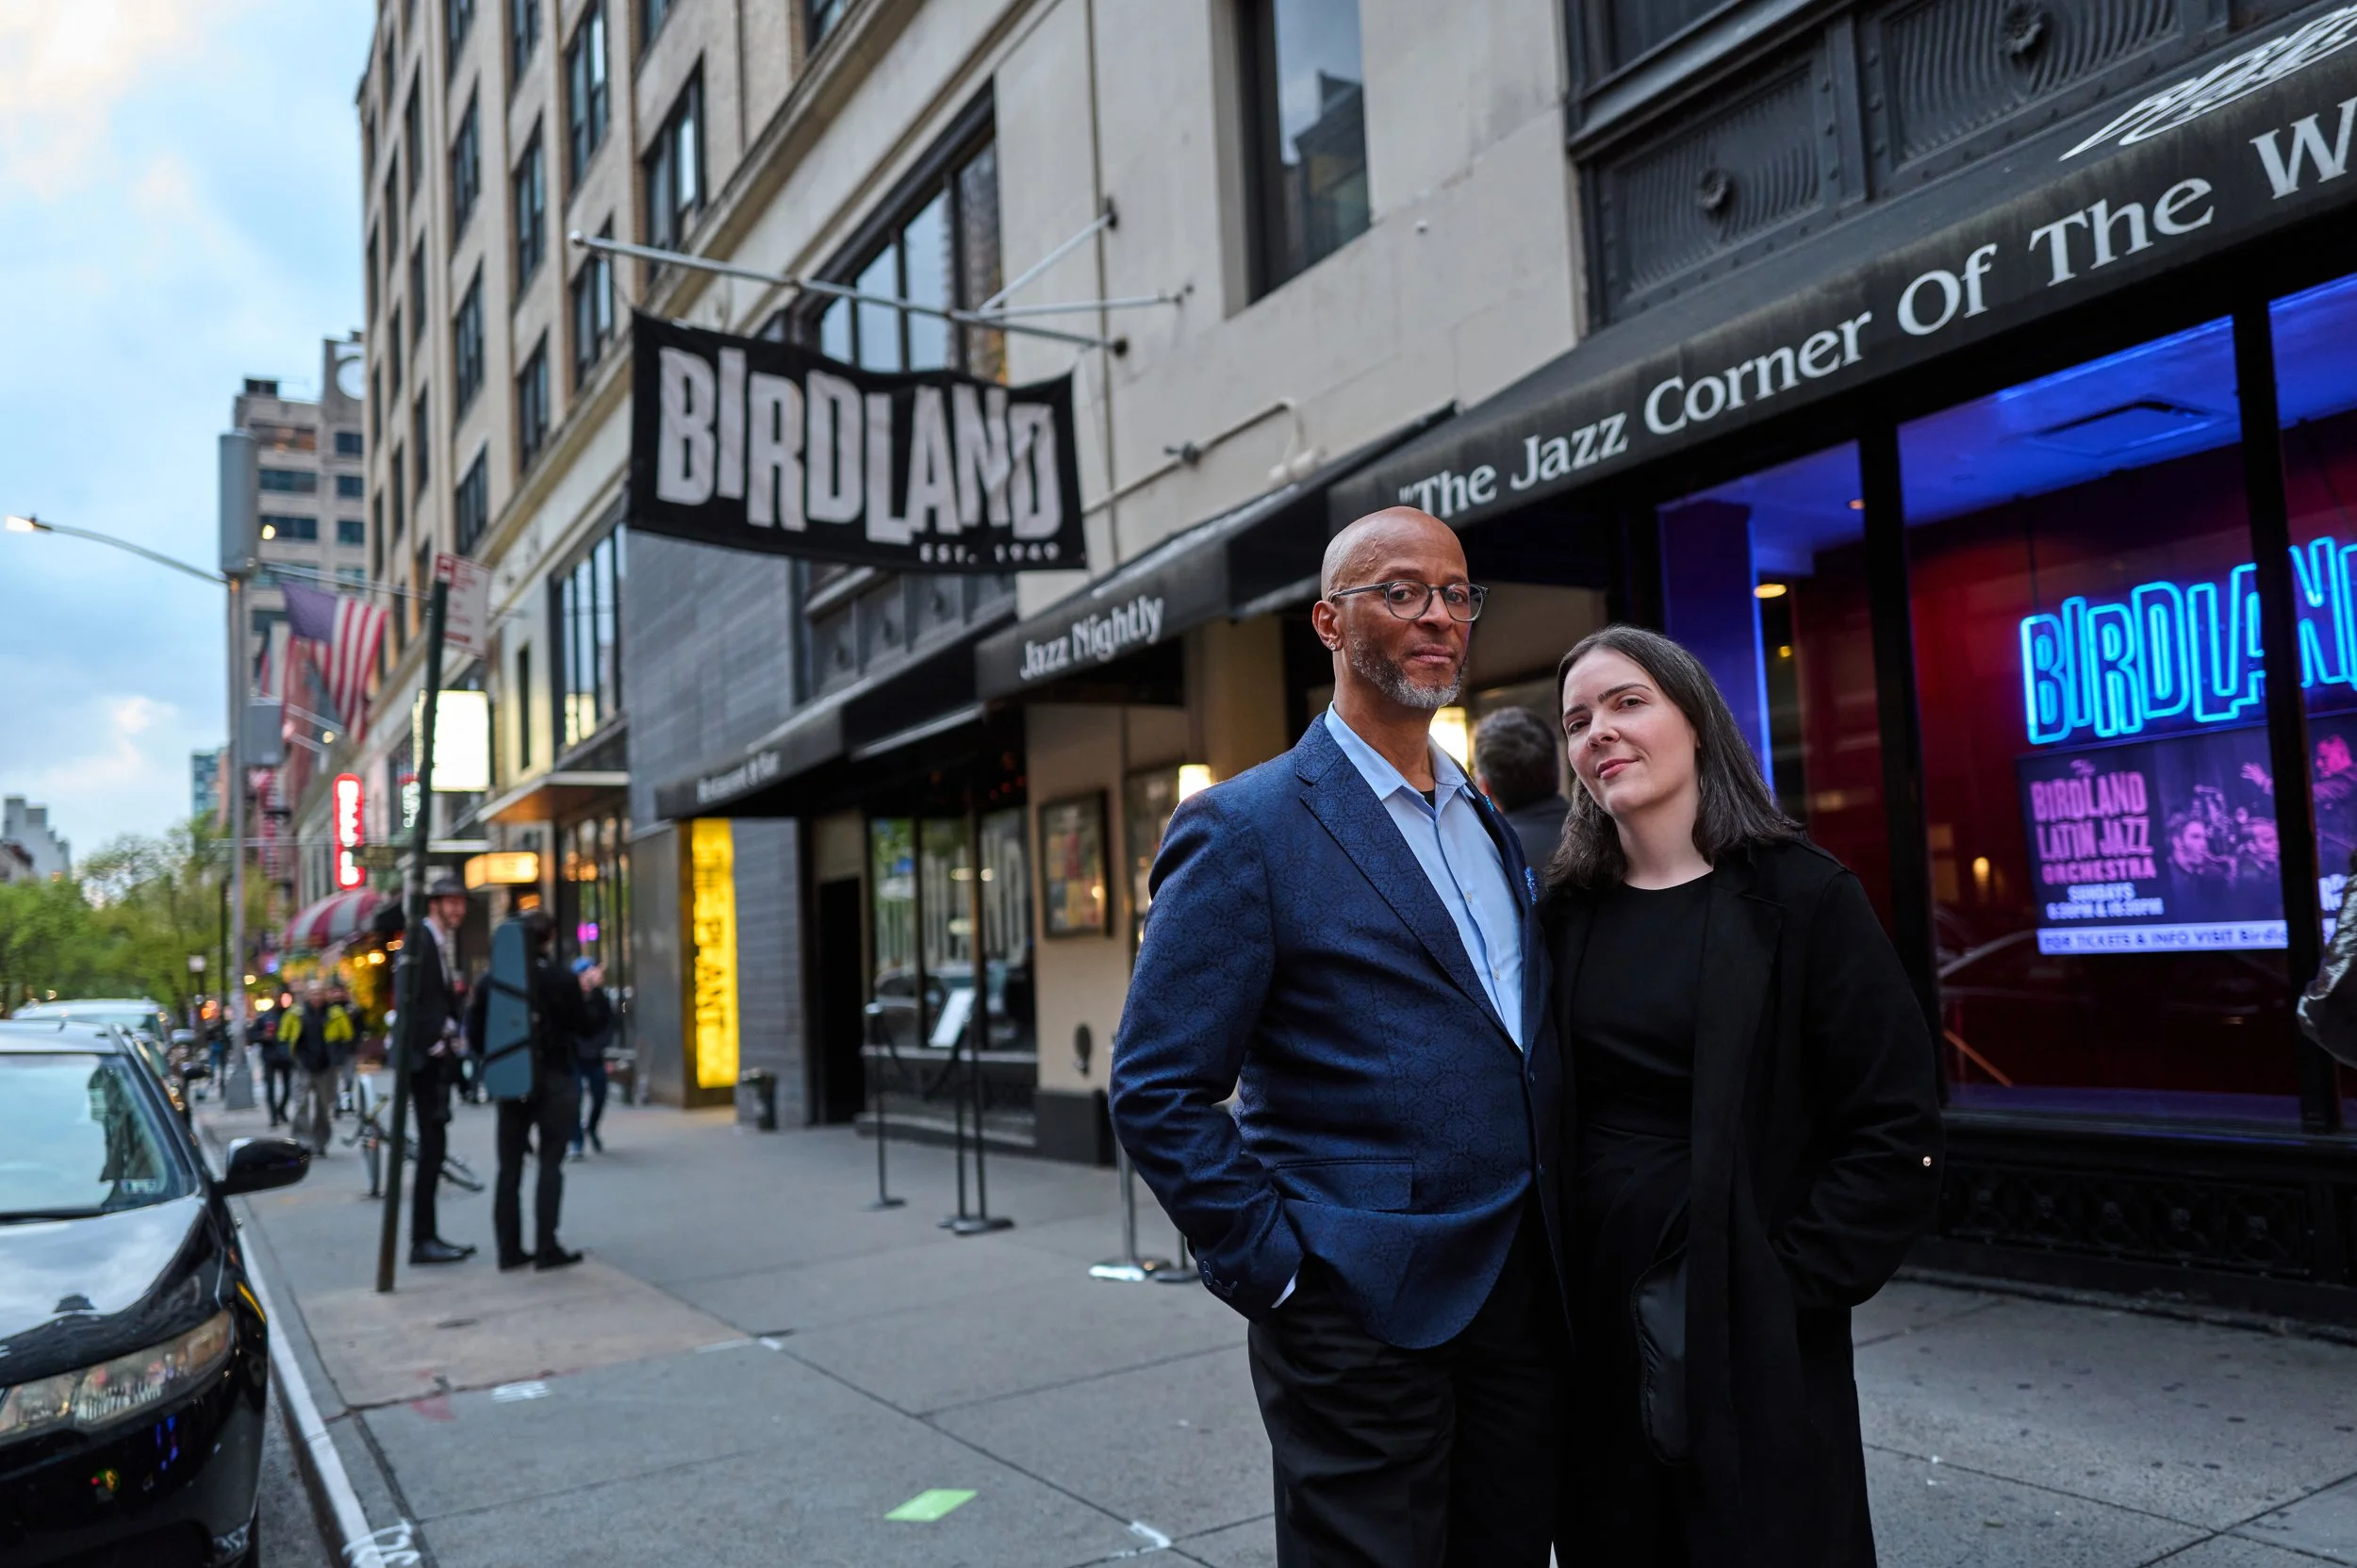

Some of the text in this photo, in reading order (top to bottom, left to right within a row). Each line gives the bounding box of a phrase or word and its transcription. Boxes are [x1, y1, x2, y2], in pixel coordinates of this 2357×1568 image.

[1510, 412, 1628, 490] Jazz
[1643, 310, 1872, 435] Corner
[1897, 242, 1997, 335] Of
[2028, 177, 2214, 287] The
[655, 346, 1063, 545] BIRDLAND
[1019, 594, 1164, 681] Jazz Nightly
[2030, 770, 2149, 823] BIRDLAND
[2036, 815, 2154, 862] LATIN JAZZ
[2041, 855, 2158, 884] ORCHESTRA
